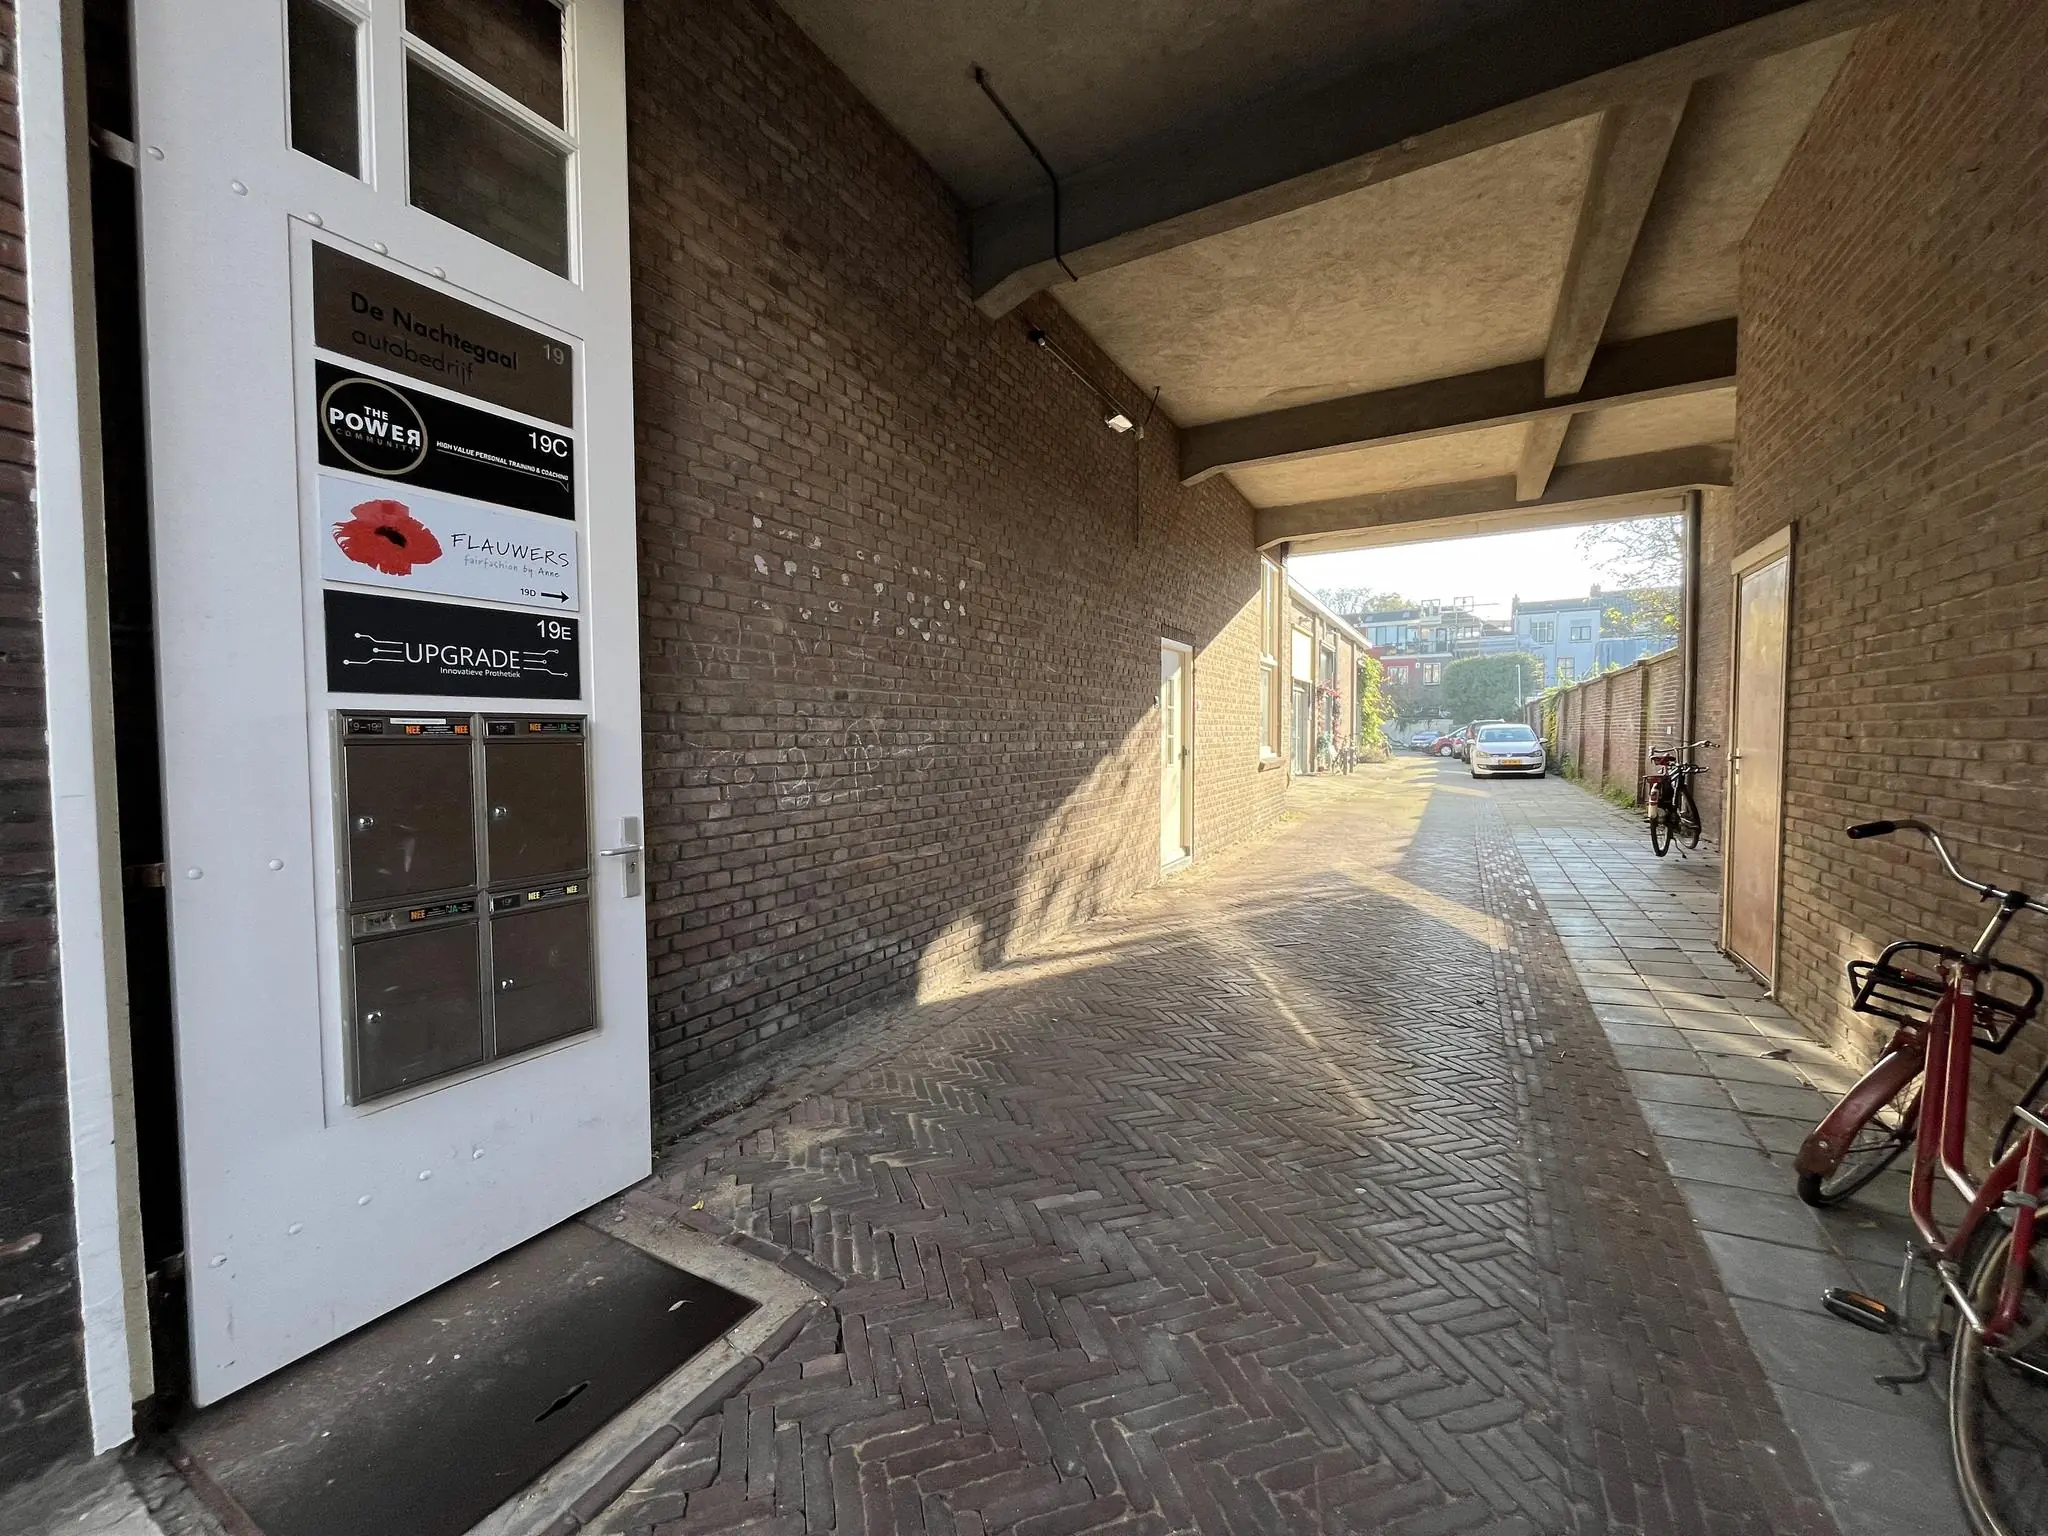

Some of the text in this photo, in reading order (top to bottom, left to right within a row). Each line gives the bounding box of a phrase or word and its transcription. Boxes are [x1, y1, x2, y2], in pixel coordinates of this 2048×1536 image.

[351, 291, 519, 371] De Nachtegaal
[351, 329, 474, 386] autobedrijf
[543, 344, 565, 365] 19
[363, 405, 389, 421] THE
[329, 407, 421, 447] POWER
[335, 427, 415, 453] COMMUNITY
[528, 432, 568, 458] 19C
[436, 440, 453, 450] HIGH
[453, 445, 475, 457] VALUE
[475, 451, 508, 466] PERSONAL
[508, 460, 536, 473] TRAINING
[541, 468, 569, 481] COACHING
[451, 533, 570, 568] FLAUWERS
[464, 554, 560, 578] fairfashion by Anne
[520, 588, 537, 597] 19D
[537, 619, 572, 641] 19E
[405, 642, 521, 670] UPGRADE
[440, 667, 521, 678] Innovatieve Prothetiek
[406, 725, 420, 734] NEE
[455, 725, 468, 734] NEE
[529, 723, 543, 732] NEE
[528, 892, 541, 901] NEE
[566, 885, 578, 895] NEE
[411, 910, 425, 920] NEE
